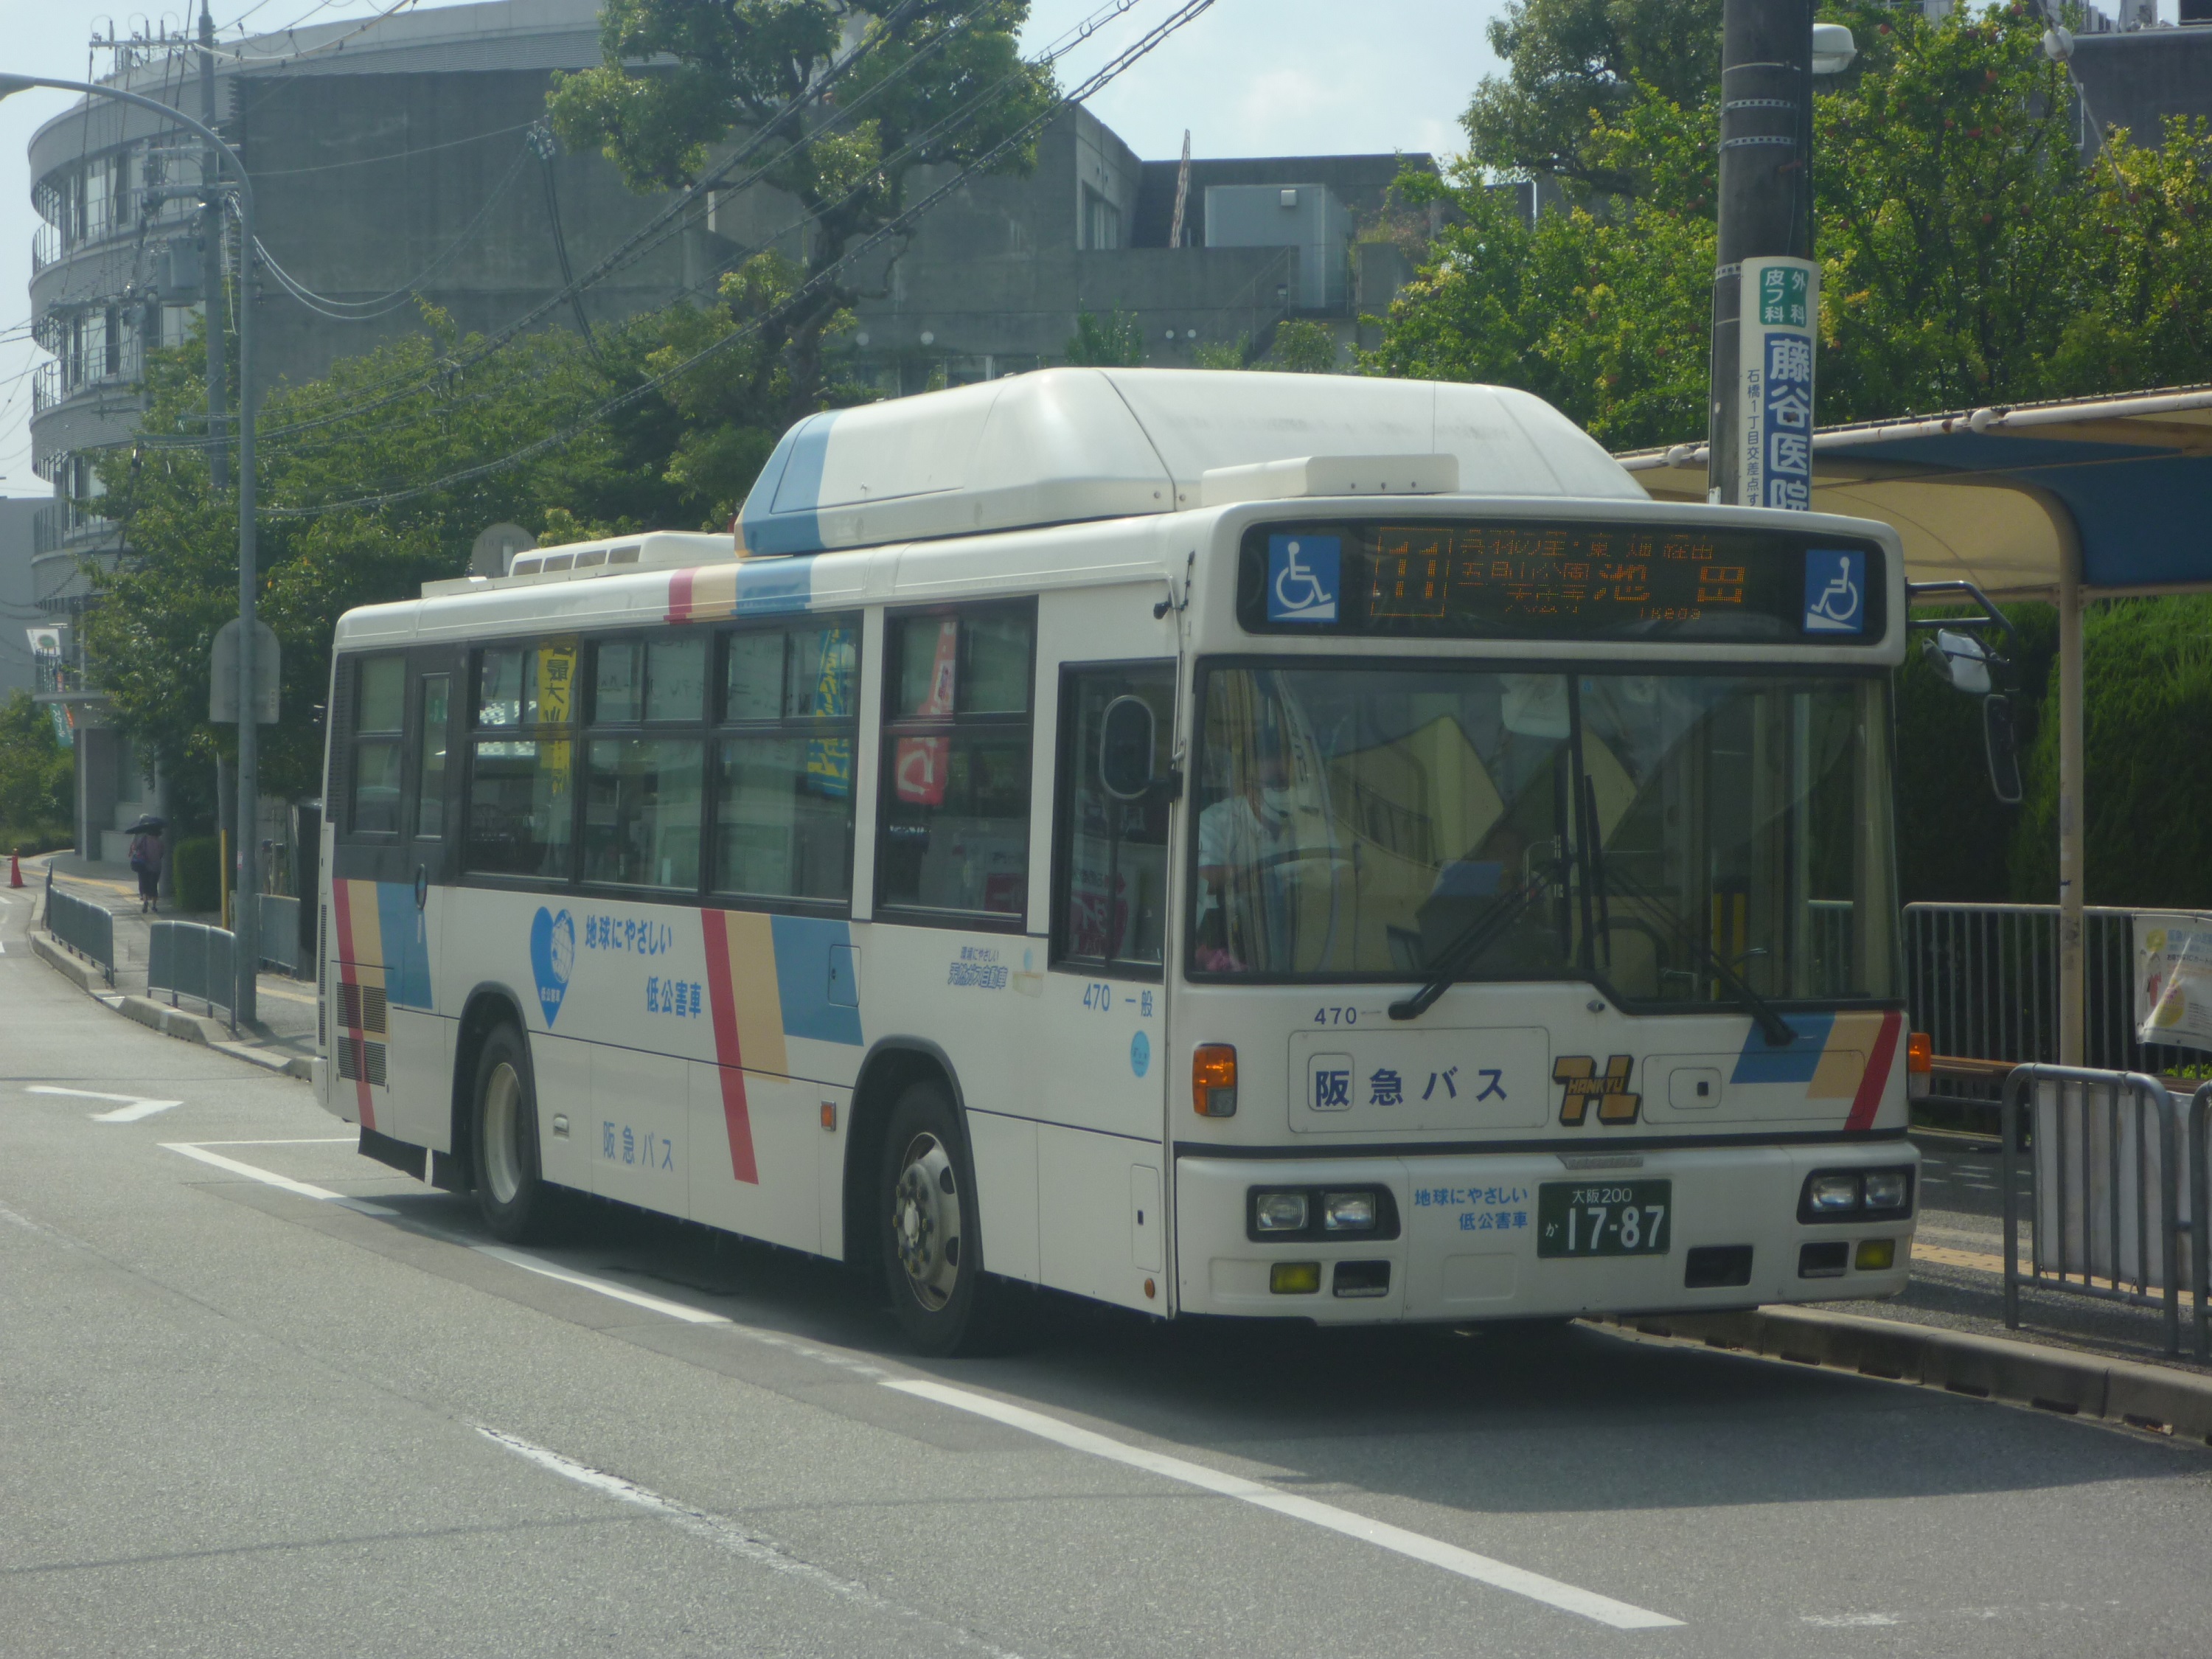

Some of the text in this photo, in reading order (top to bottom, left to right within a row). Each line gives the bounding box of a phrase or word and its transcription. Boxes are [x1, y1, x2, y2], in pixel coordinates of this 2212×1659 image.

[1765, 269, 1785, 324] 皮フ科
[1790, 271, 1806, 325] 外科
[1767, 337, 1810, 511] 藤谷医院
[1388, 540, 1439, 599] 11
[1593, 563, 1746, 603] 池田
[585, 915, 672, 956] 地球にやさしい
[647, 975, 701, 1019] 低公害車
[1083, 983, 1153, 1018] 470 一般
[1314, 1006, 1357, 1026] 470
[1315, 1065, 1507, 1107] 阪急バス
[1568, 1077, 1624, 1095] HANKYU
[602, 1121, 673, 1172] 阪急バス
[1414, 1187, 1528, 1207] 地球にやさしい
[1459, 1211, 1528, 1231] 低公害車
[1545, 1205, 1665, 1251] か 17-87
